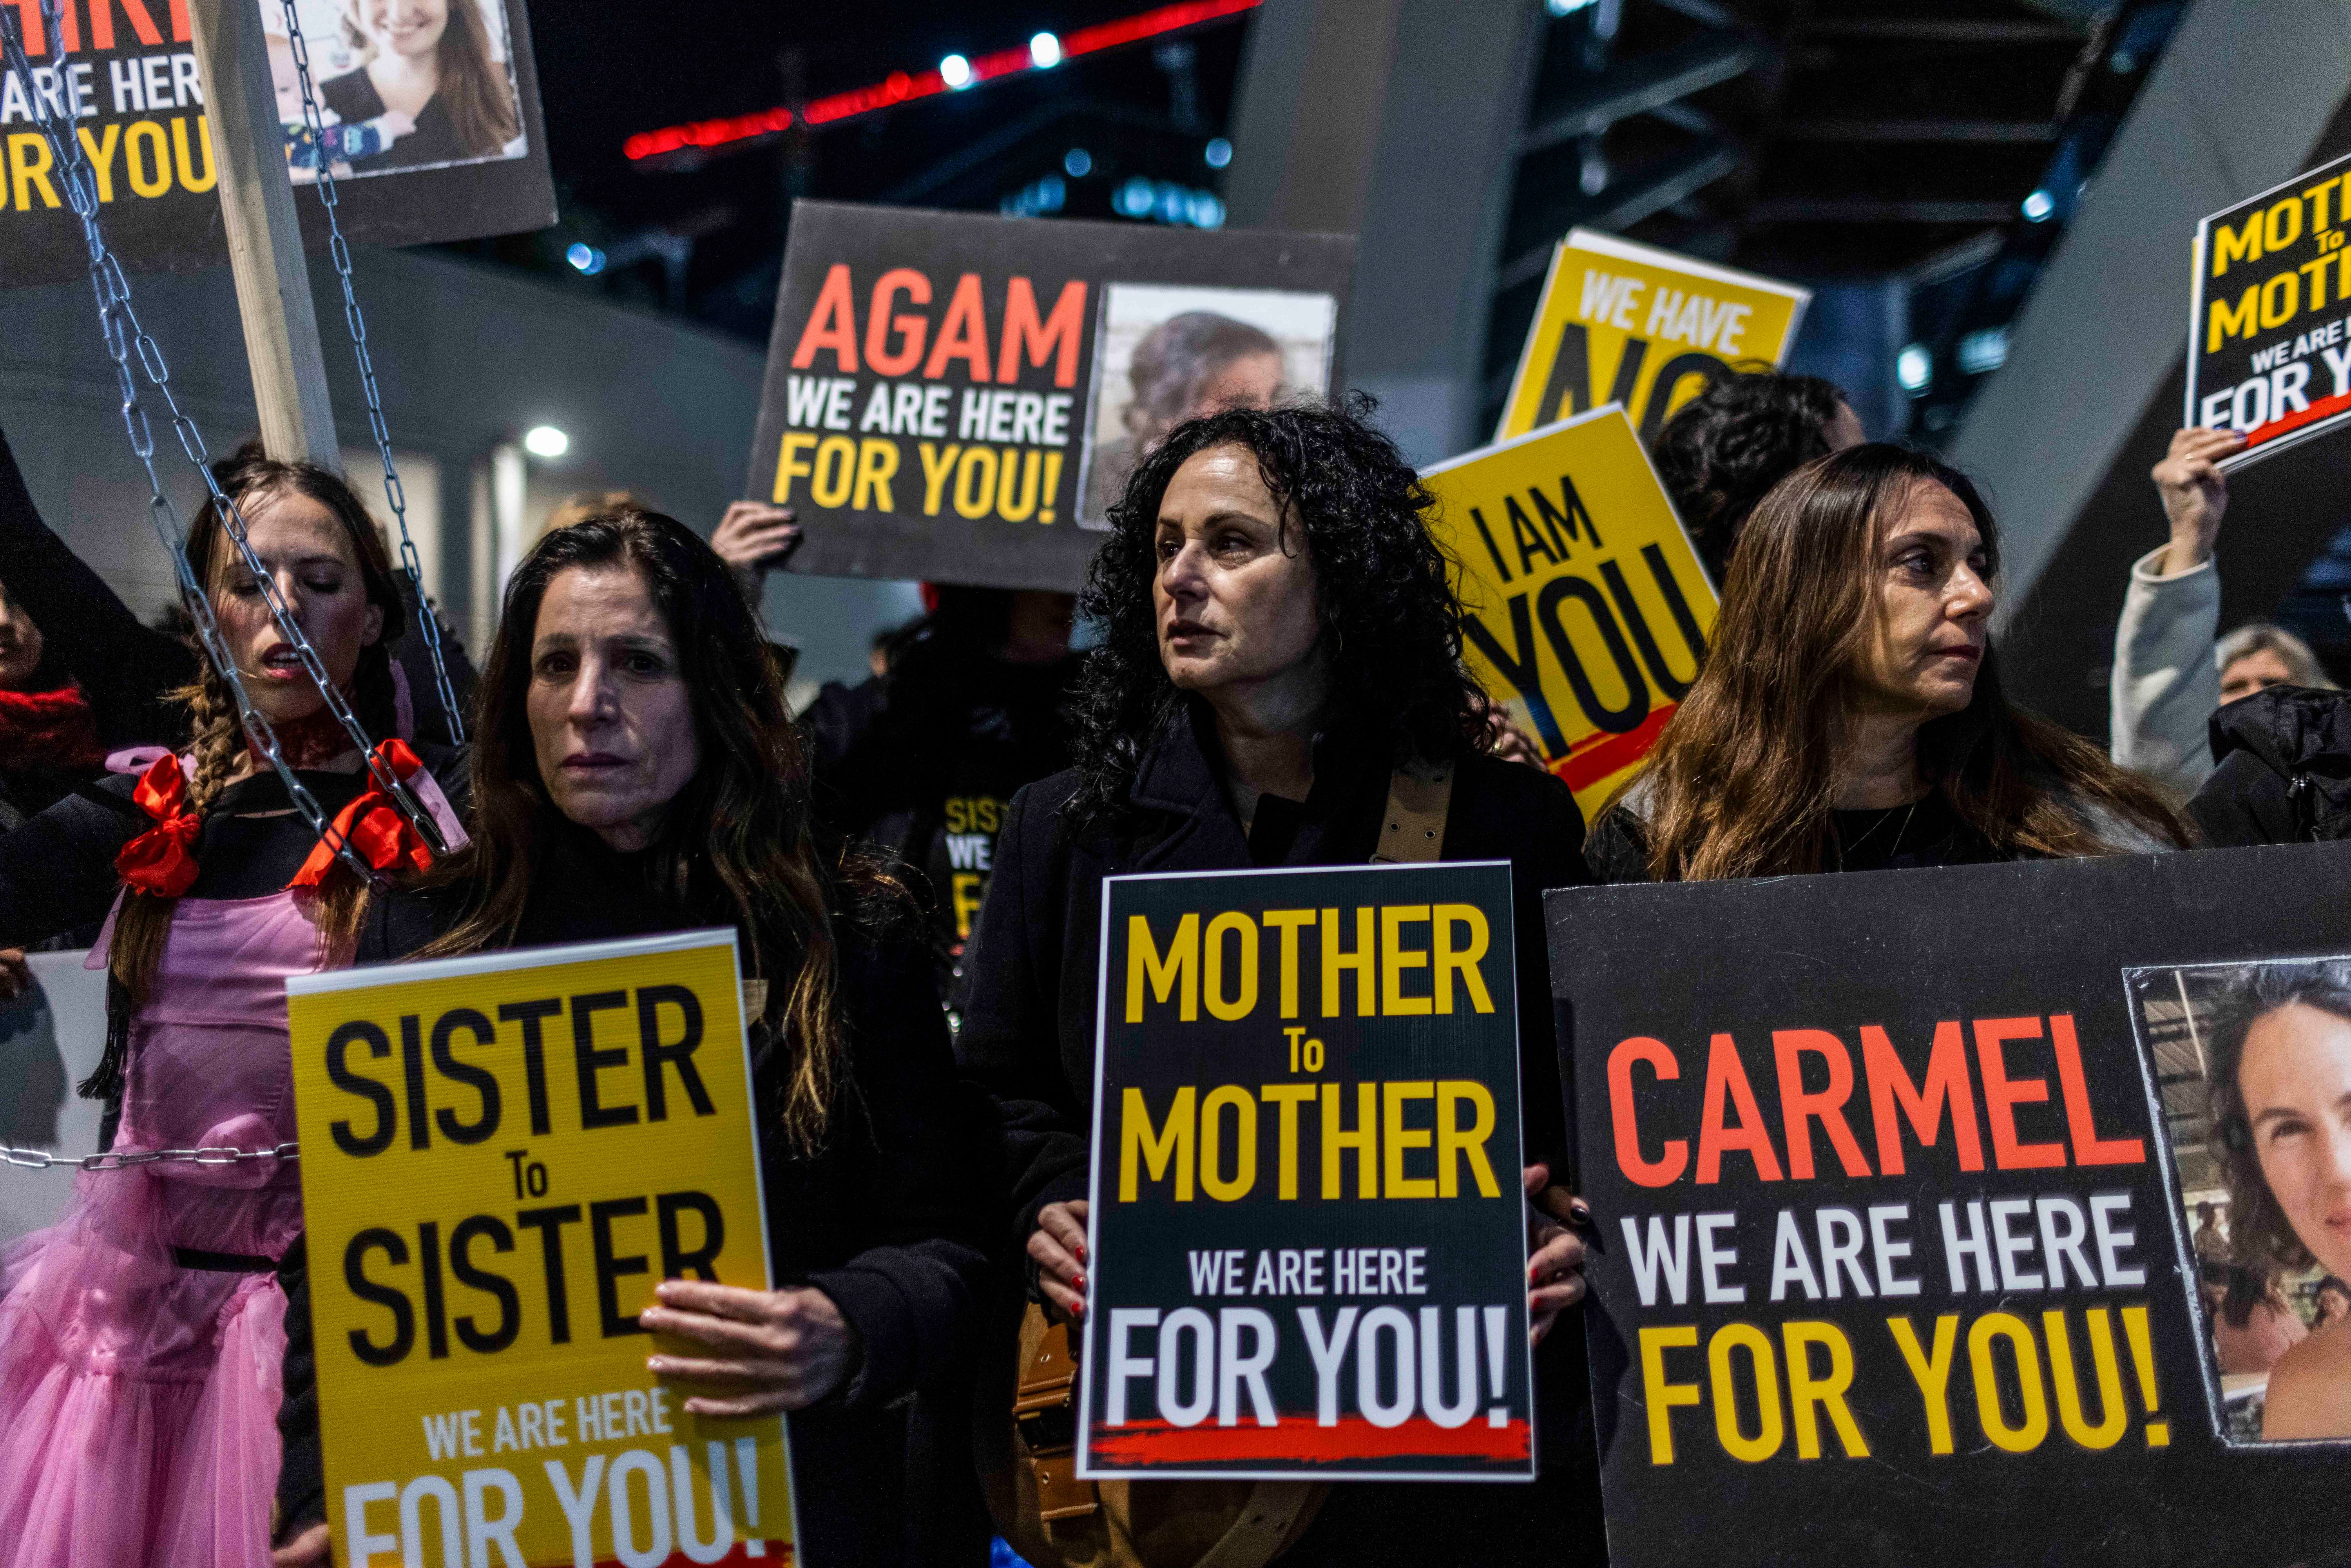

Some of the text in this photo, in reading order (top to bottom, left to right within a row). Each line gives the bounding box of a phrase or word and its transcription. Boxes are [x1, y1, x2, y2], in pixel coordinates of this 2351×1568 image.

[0, 53, 204, 124] ARE HER
[2315, 229, 2346, 254] To
[791, 263, 1088, 388] AGAM
[1579, 269, 1753, 356] WE HAVE
[2251, 340, 2292, 375] WE
[2291, 319, 2344, 360] ARE
[787, 375, 1074, 445] WE ARE HERE
[2199, 361, 2310, 433] FOR
[773, 432, 1063, 524] FOR YOU!
[1469, 475, 1603, 583] I AM
[1462, 543, 1709, 759] YOU
[944, 797, 1006, 834] SIS
[945, 833, 992, 871] WE
[1125, 904, 1495, 1023] MOTHER
[324, 983, 717, 1159] SISTER
[1283, 1027, 1324, 1073] To
[1119, 1080, 1501, 1203] MOTHER
[1607, 1014, 2146, 1188] CARMEL
[504, 1149, 549, 1200] To
[342, 1192, 723, 1368] SISTER
[1189, 1248, 1427, 1295] WE ARE HERE
[1619, 1194, 2146, 1306] WE ARE HERE
[1106, 1305, 1508, 1429] FOR YOU!
[1638, 1306, 2170, 1465] FOR YOU!
[422, 1387, 673, 1461] WE ARE HERE
[344, 1437, 766, 1568] FOR YOU!
